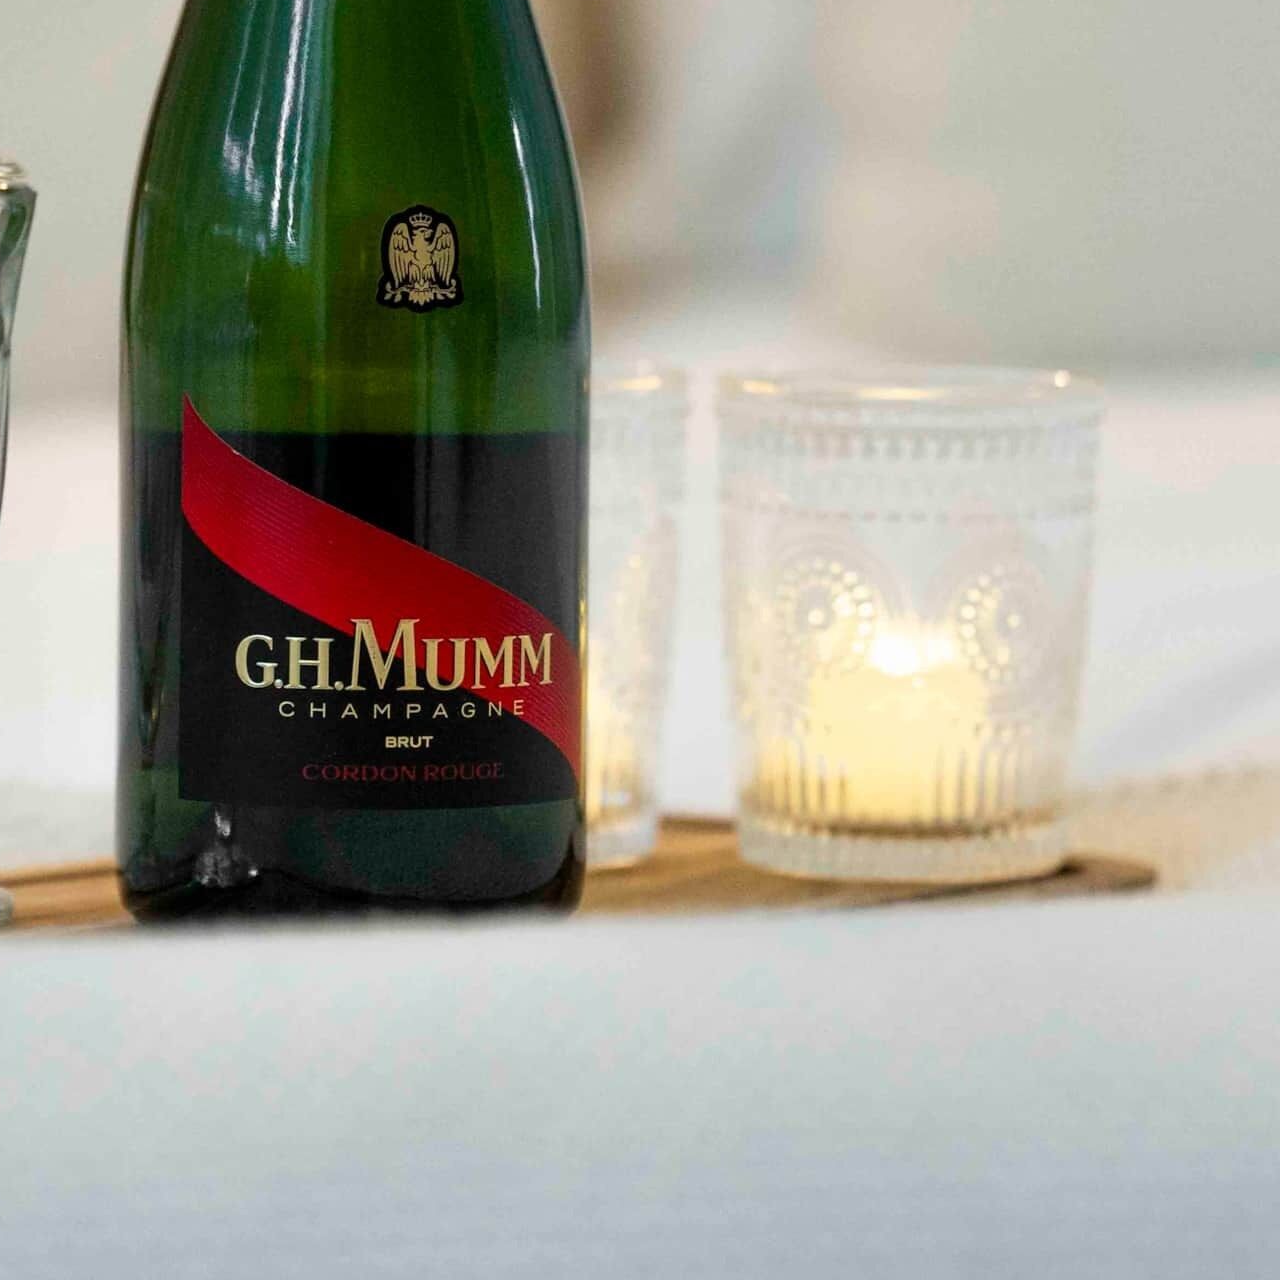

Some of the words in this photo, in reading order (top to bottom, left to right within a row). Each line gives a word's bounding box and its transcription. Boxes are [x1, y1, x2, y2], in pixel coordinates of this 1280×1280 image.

[278, 699, 524, 719] CHAMPAGNE
[385, 736, 434, 749] BRUT
[302, 764, 417, 783] CORDON
[424, 762, 505, 781] ROUGE
